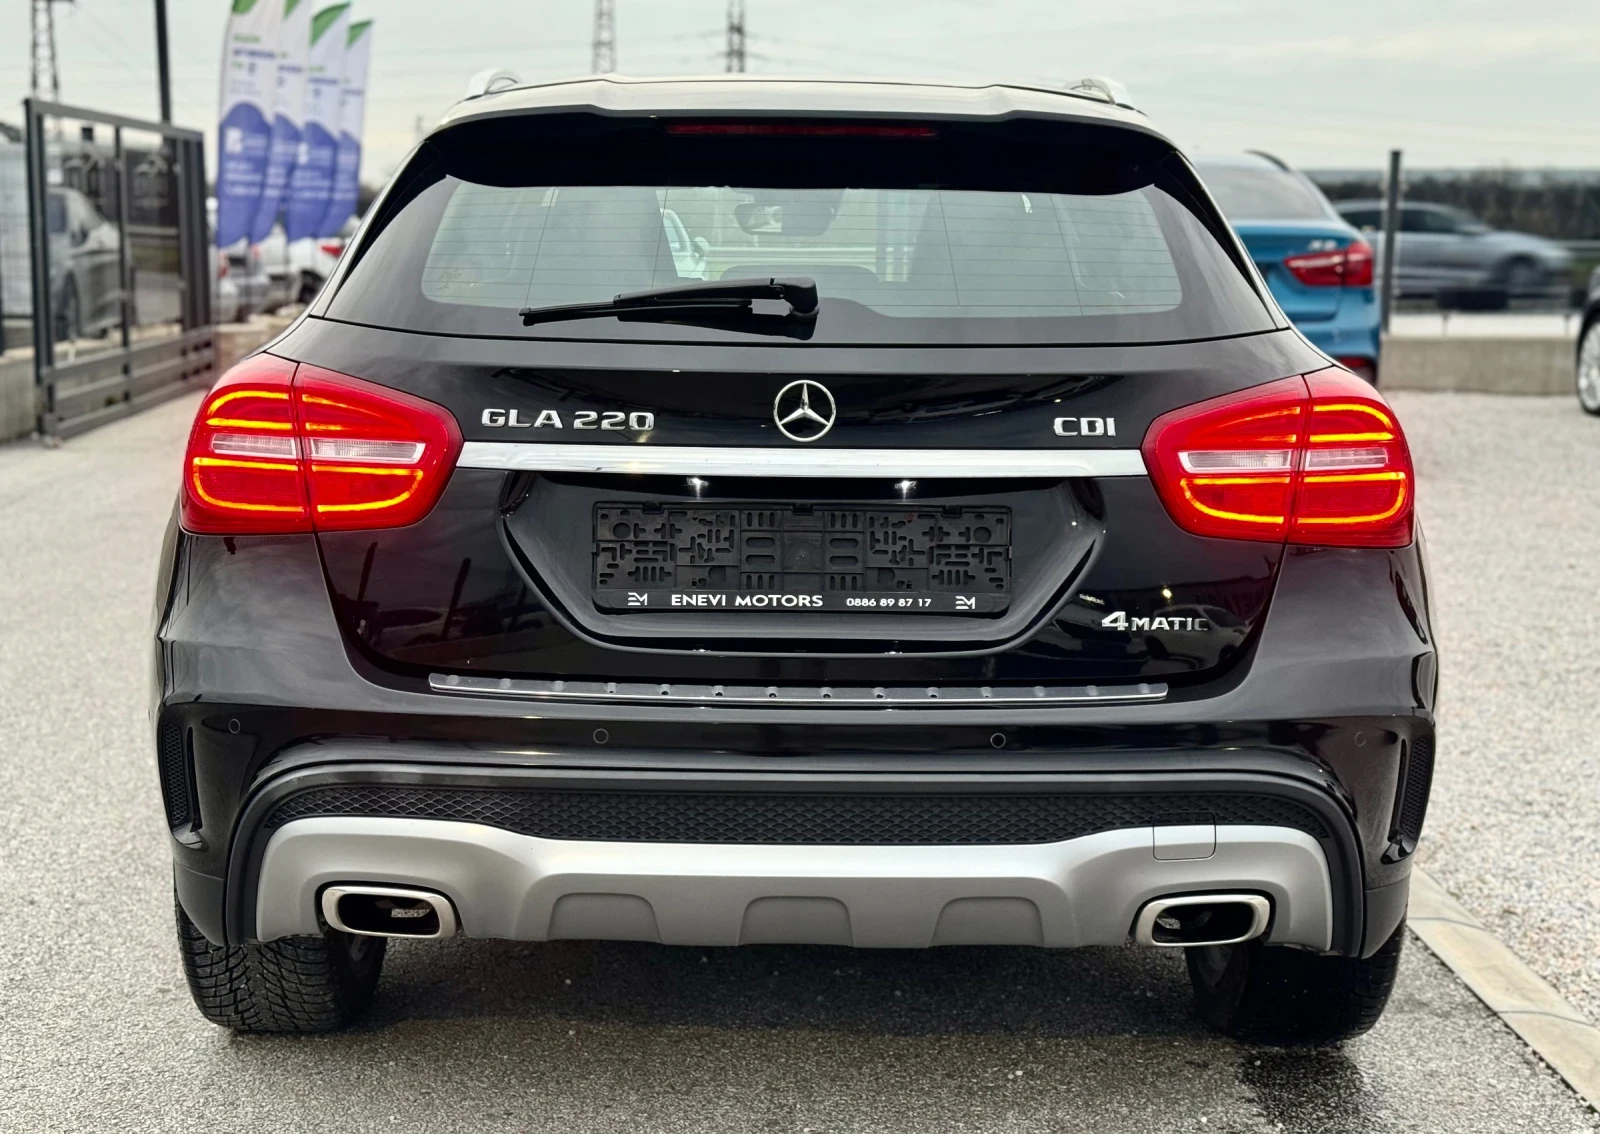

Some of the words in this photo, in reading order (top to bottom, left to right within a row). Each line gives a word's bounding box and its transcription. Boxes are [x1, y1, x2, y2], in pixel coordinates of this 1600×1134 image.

[481, 408, 563, 430] GLA
[573, 410, 655, 431] 220
[1053, 417, 1117, 437] CDI
[671, 594, 727, 606] ENEVI
[734, 594, 824, 607] MOTORS
[846, 597, 877, 607] 0886
[879, 598, 896, 607] 89
[898, 598, 914, 607] 87
[917, 598, 932, 607] 17
[1101, 611, 1209, 631] 4MATIC
